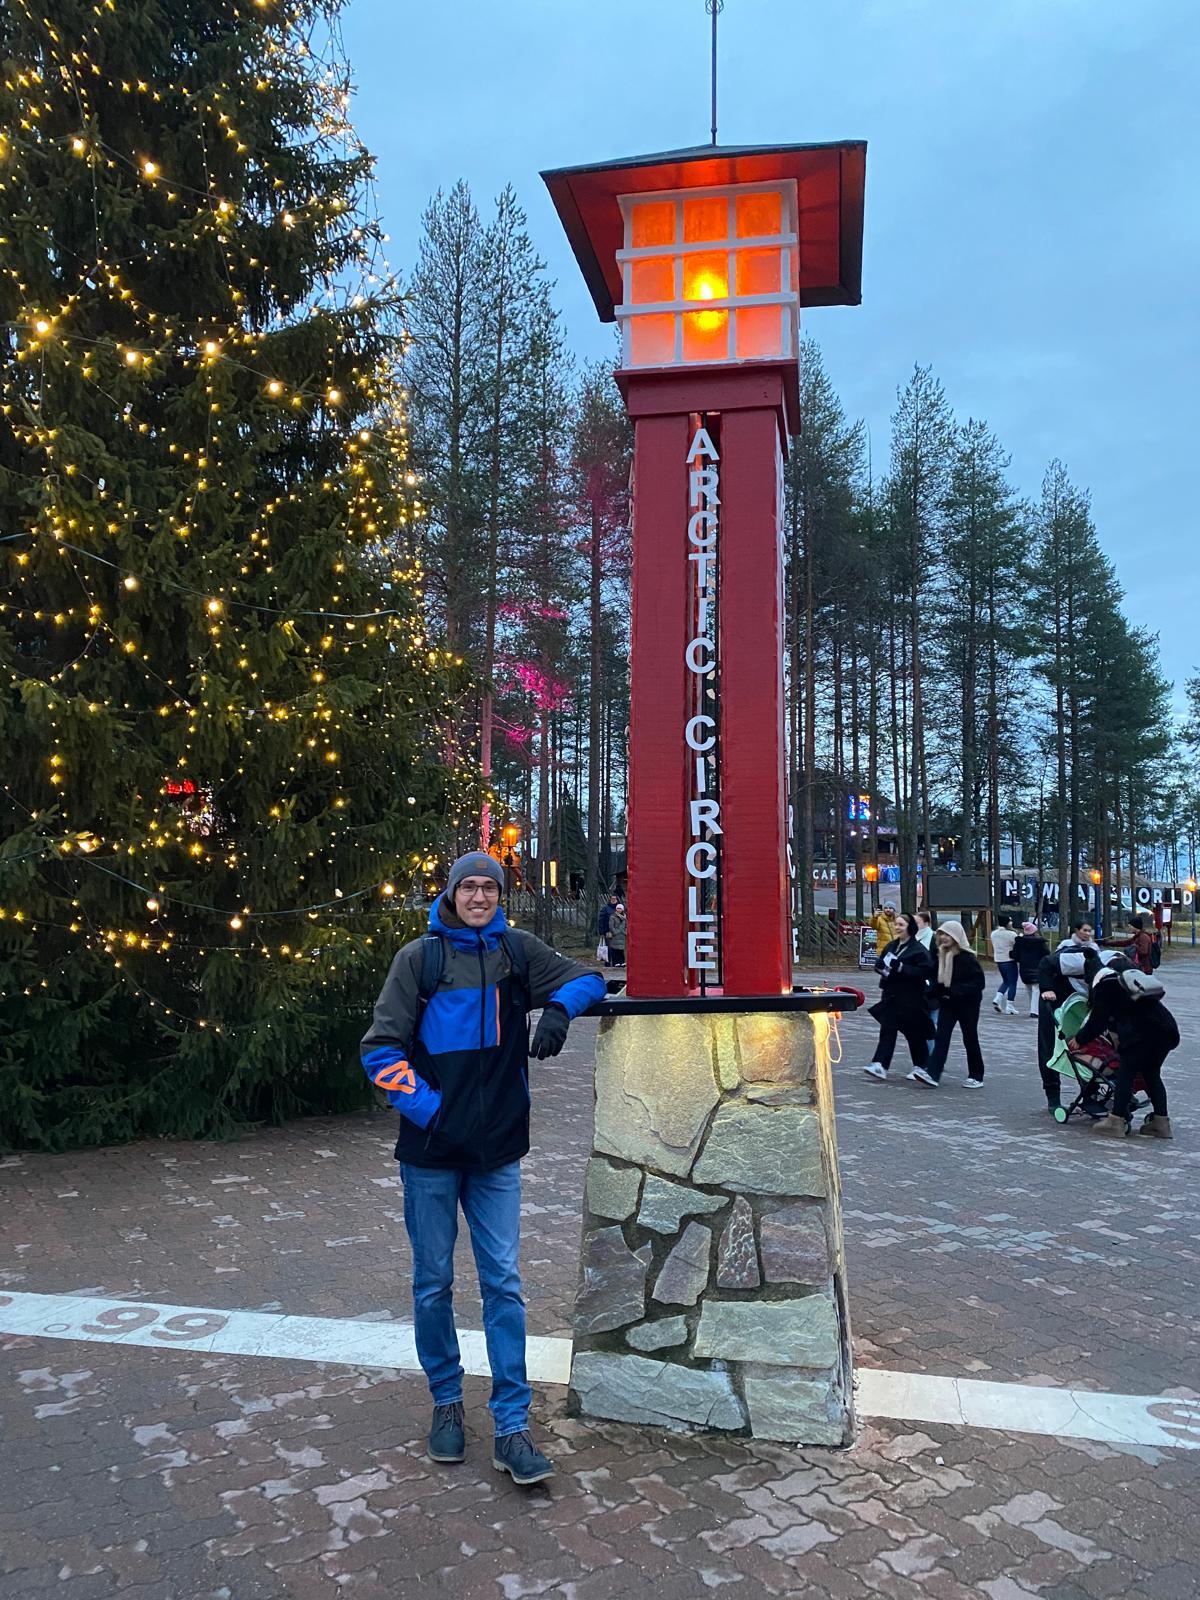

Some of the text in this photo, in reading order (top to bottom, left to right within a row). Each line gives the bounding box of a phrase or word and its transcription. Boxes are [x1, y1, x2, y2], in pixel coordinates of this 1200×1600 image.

[685, 428, 723, 969] ARCTIC CIRCLE
[812, 869, 837, 880] CAF
